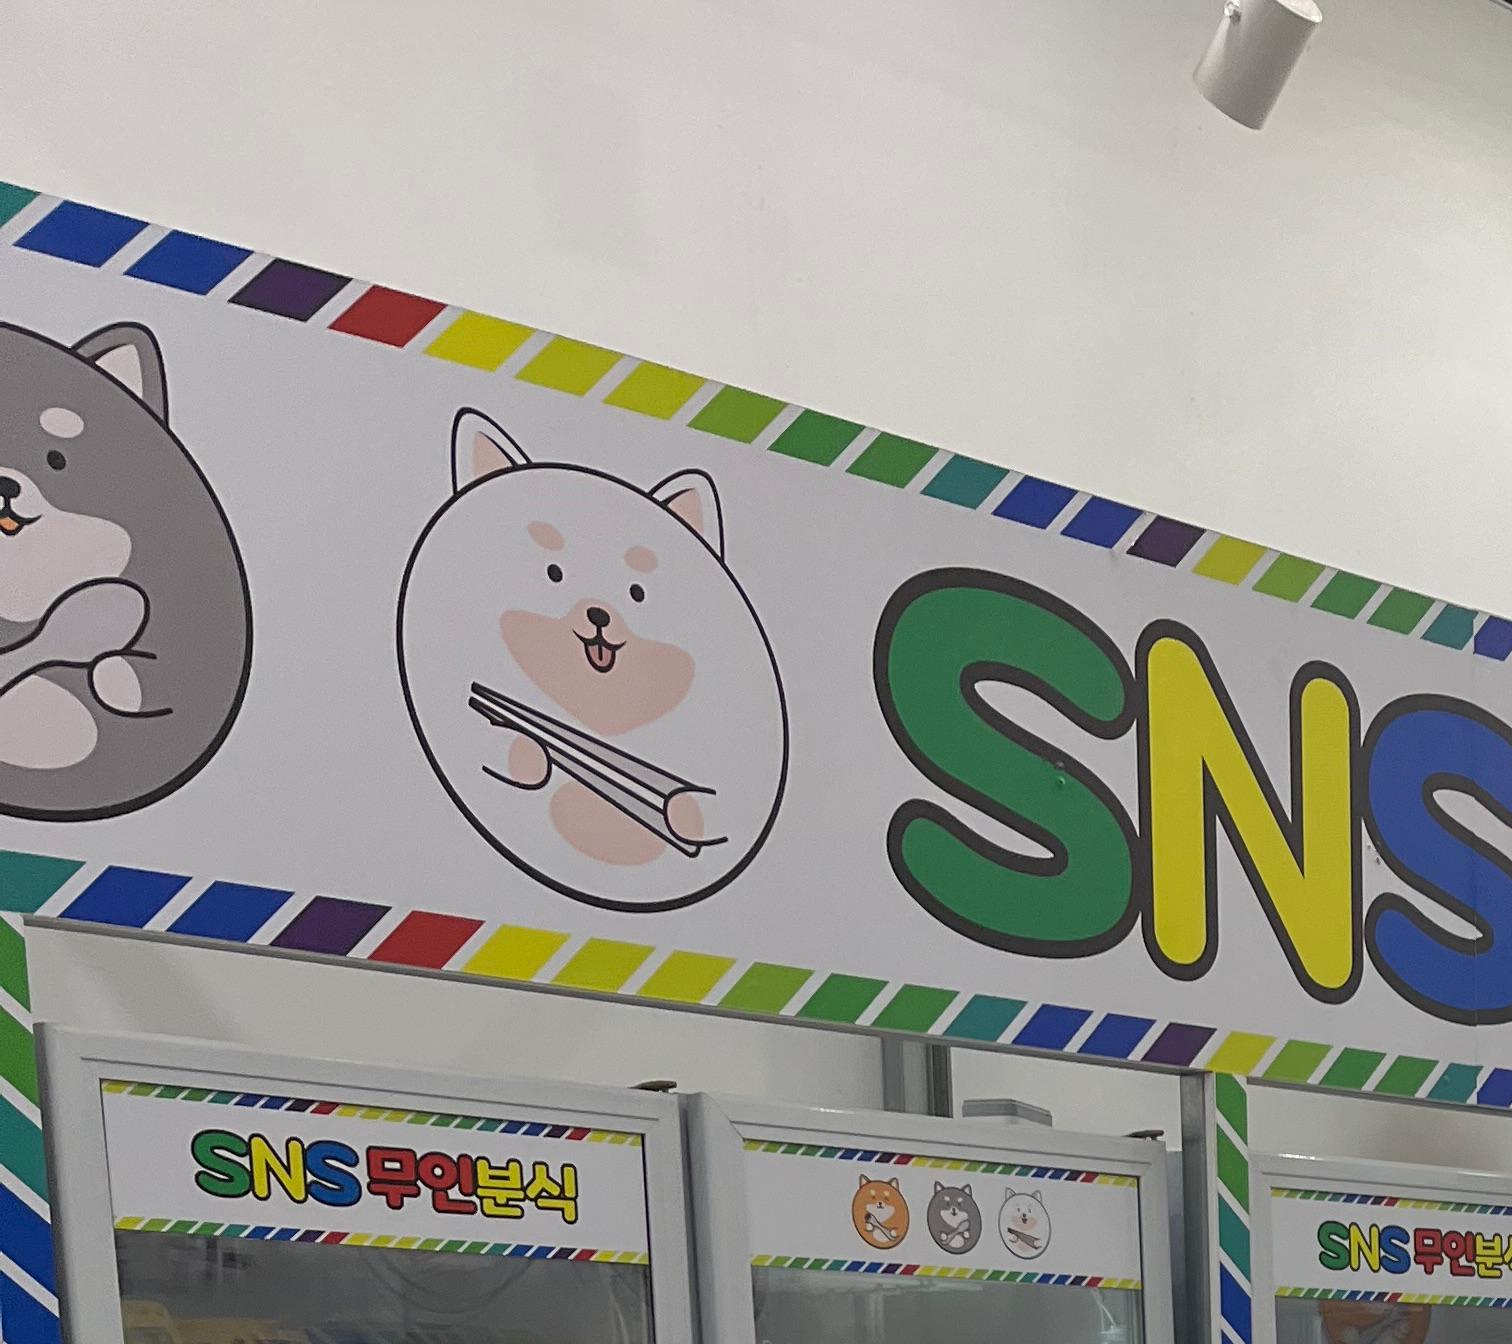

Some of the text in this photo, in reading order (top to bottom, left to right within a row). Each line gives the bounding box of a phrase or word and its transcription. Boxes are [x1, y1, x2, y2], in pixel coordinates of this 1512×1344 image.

[191, 1129, 579, 1224] SNS 무인분식
[1317, 1220, 1411, 1275] SNS
